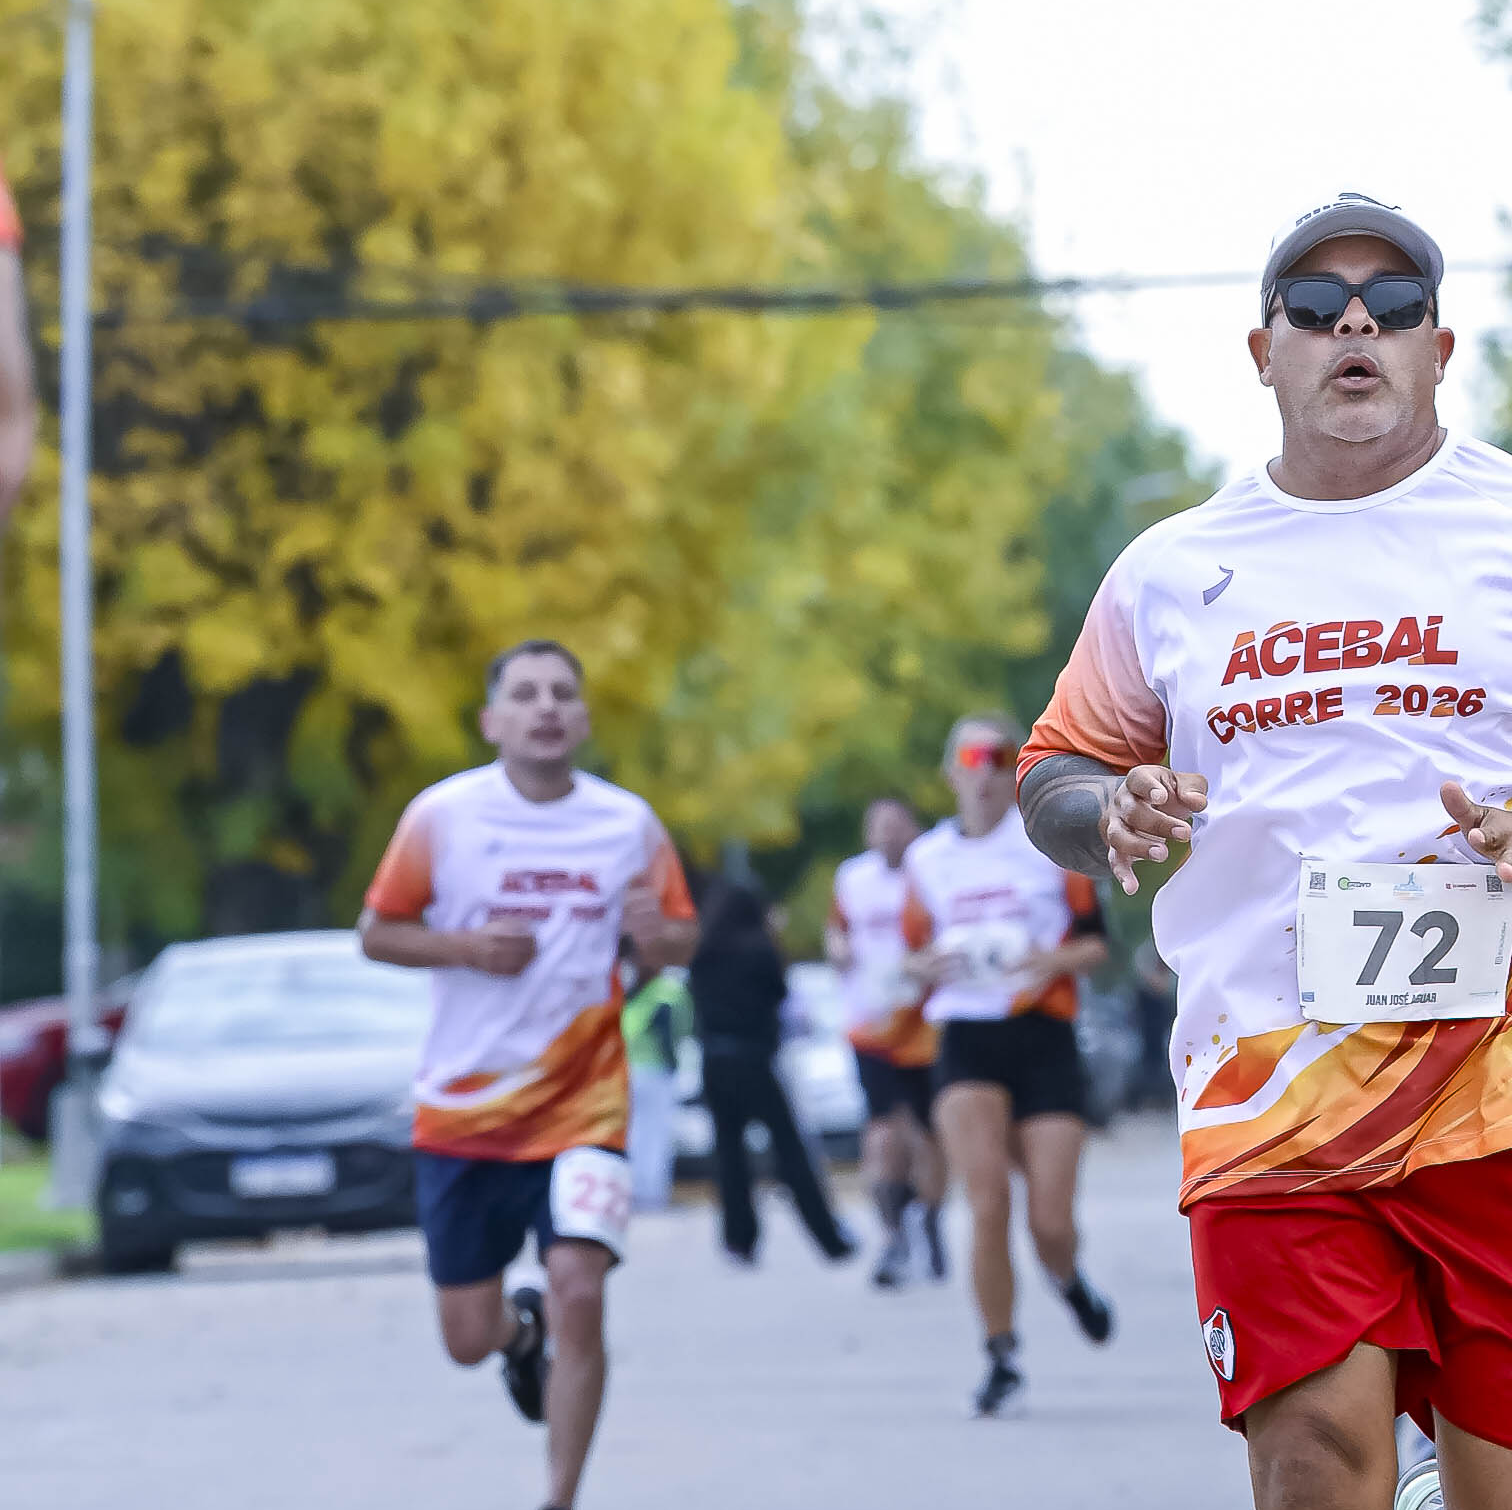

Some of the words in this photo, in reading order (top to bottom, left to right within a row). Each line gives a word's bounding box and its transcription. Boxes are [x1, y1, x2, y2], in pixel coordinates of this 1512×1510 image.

[1221, 616, 1458, 686] ACEBAL
[1206, 687, 1344, 744] CORRE
[1373, 685, 1486, 718] 2026
[1353, 910, 1459, 985] 72
[1365, 994, 1388, 1006] JUAN
